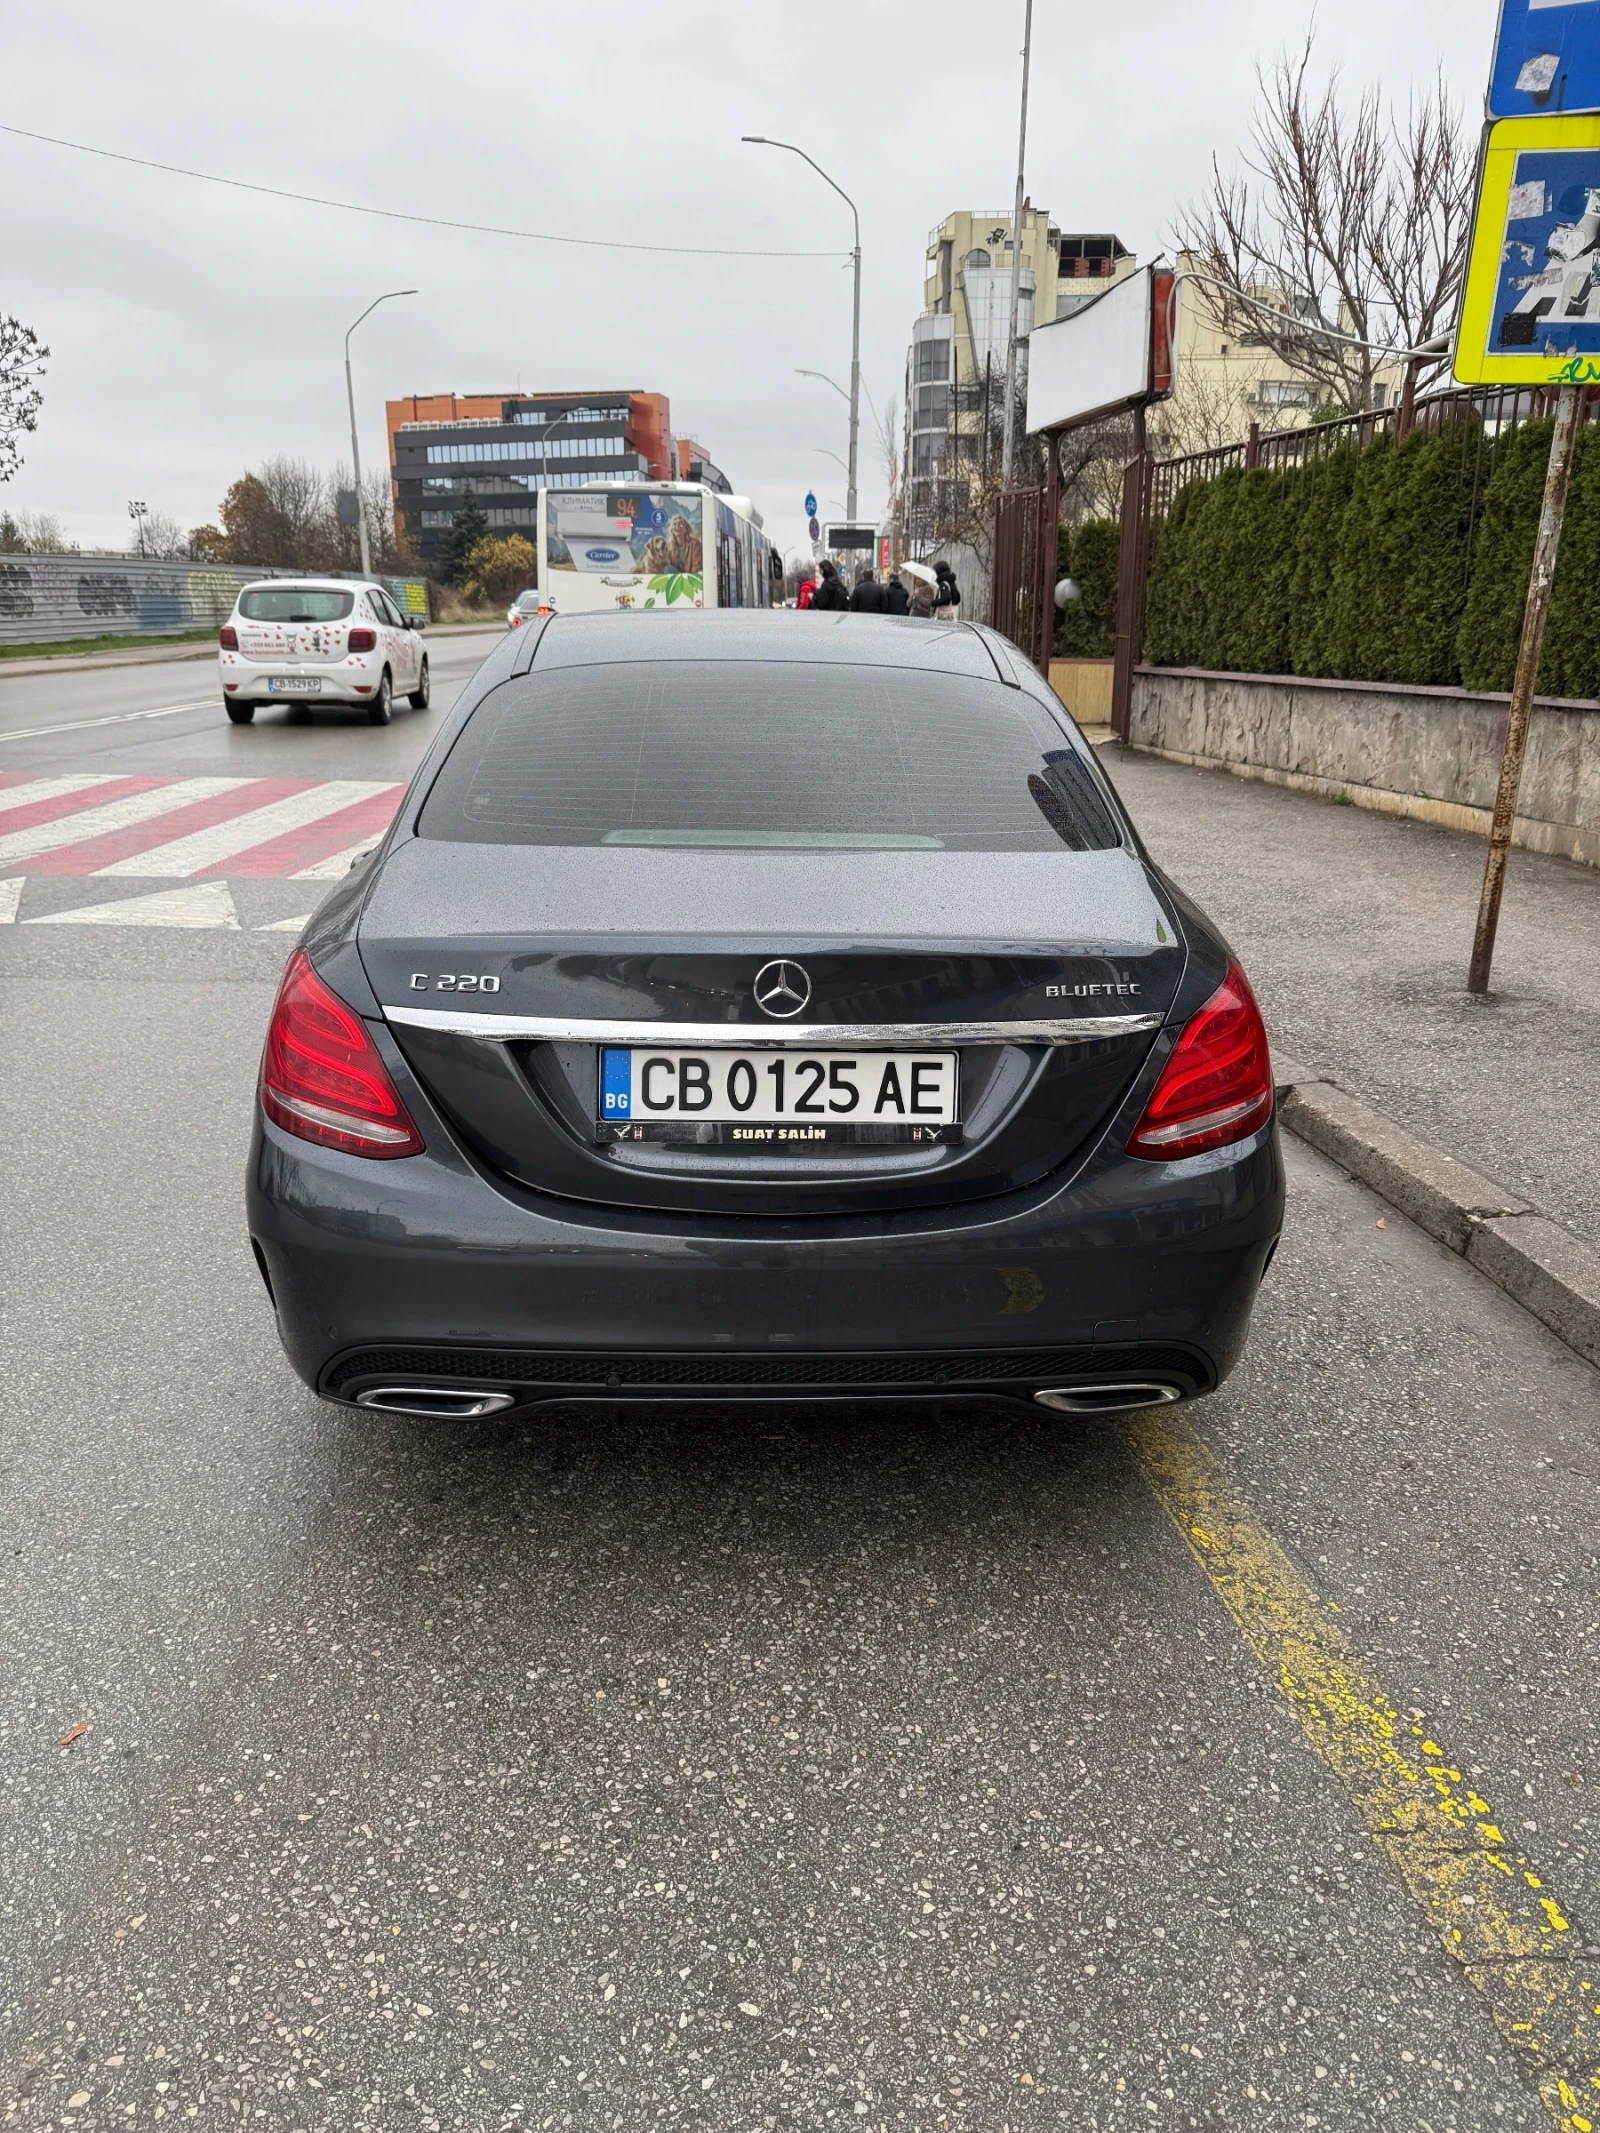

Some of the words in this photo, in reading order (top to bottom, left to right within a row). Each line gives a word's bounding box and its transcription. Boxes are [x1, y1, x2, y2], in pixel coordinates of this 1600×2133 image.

[561, 496, 605, 505] КЛИМАТИК
[617, 498, 635, 516] 94
[655, 512, 662, 521] 5
[590, 551, 617, 559] Carrier
[274, 679, 286, 688] CB
[288, 679, 307, 688] 1529
[410, 973, 429, 991] C
[436, 974, 500, 993] 220
[1045, 983, 1142, 998] BLUETEC
[641, 1057, 713, 1112] CB
[726, 1058, 860, 1114] 0125
[873, 1061, 944, 1115] AE
[605, 1093, 629, 1109] BG
[732, 1127, 775, 1140] SUAT
